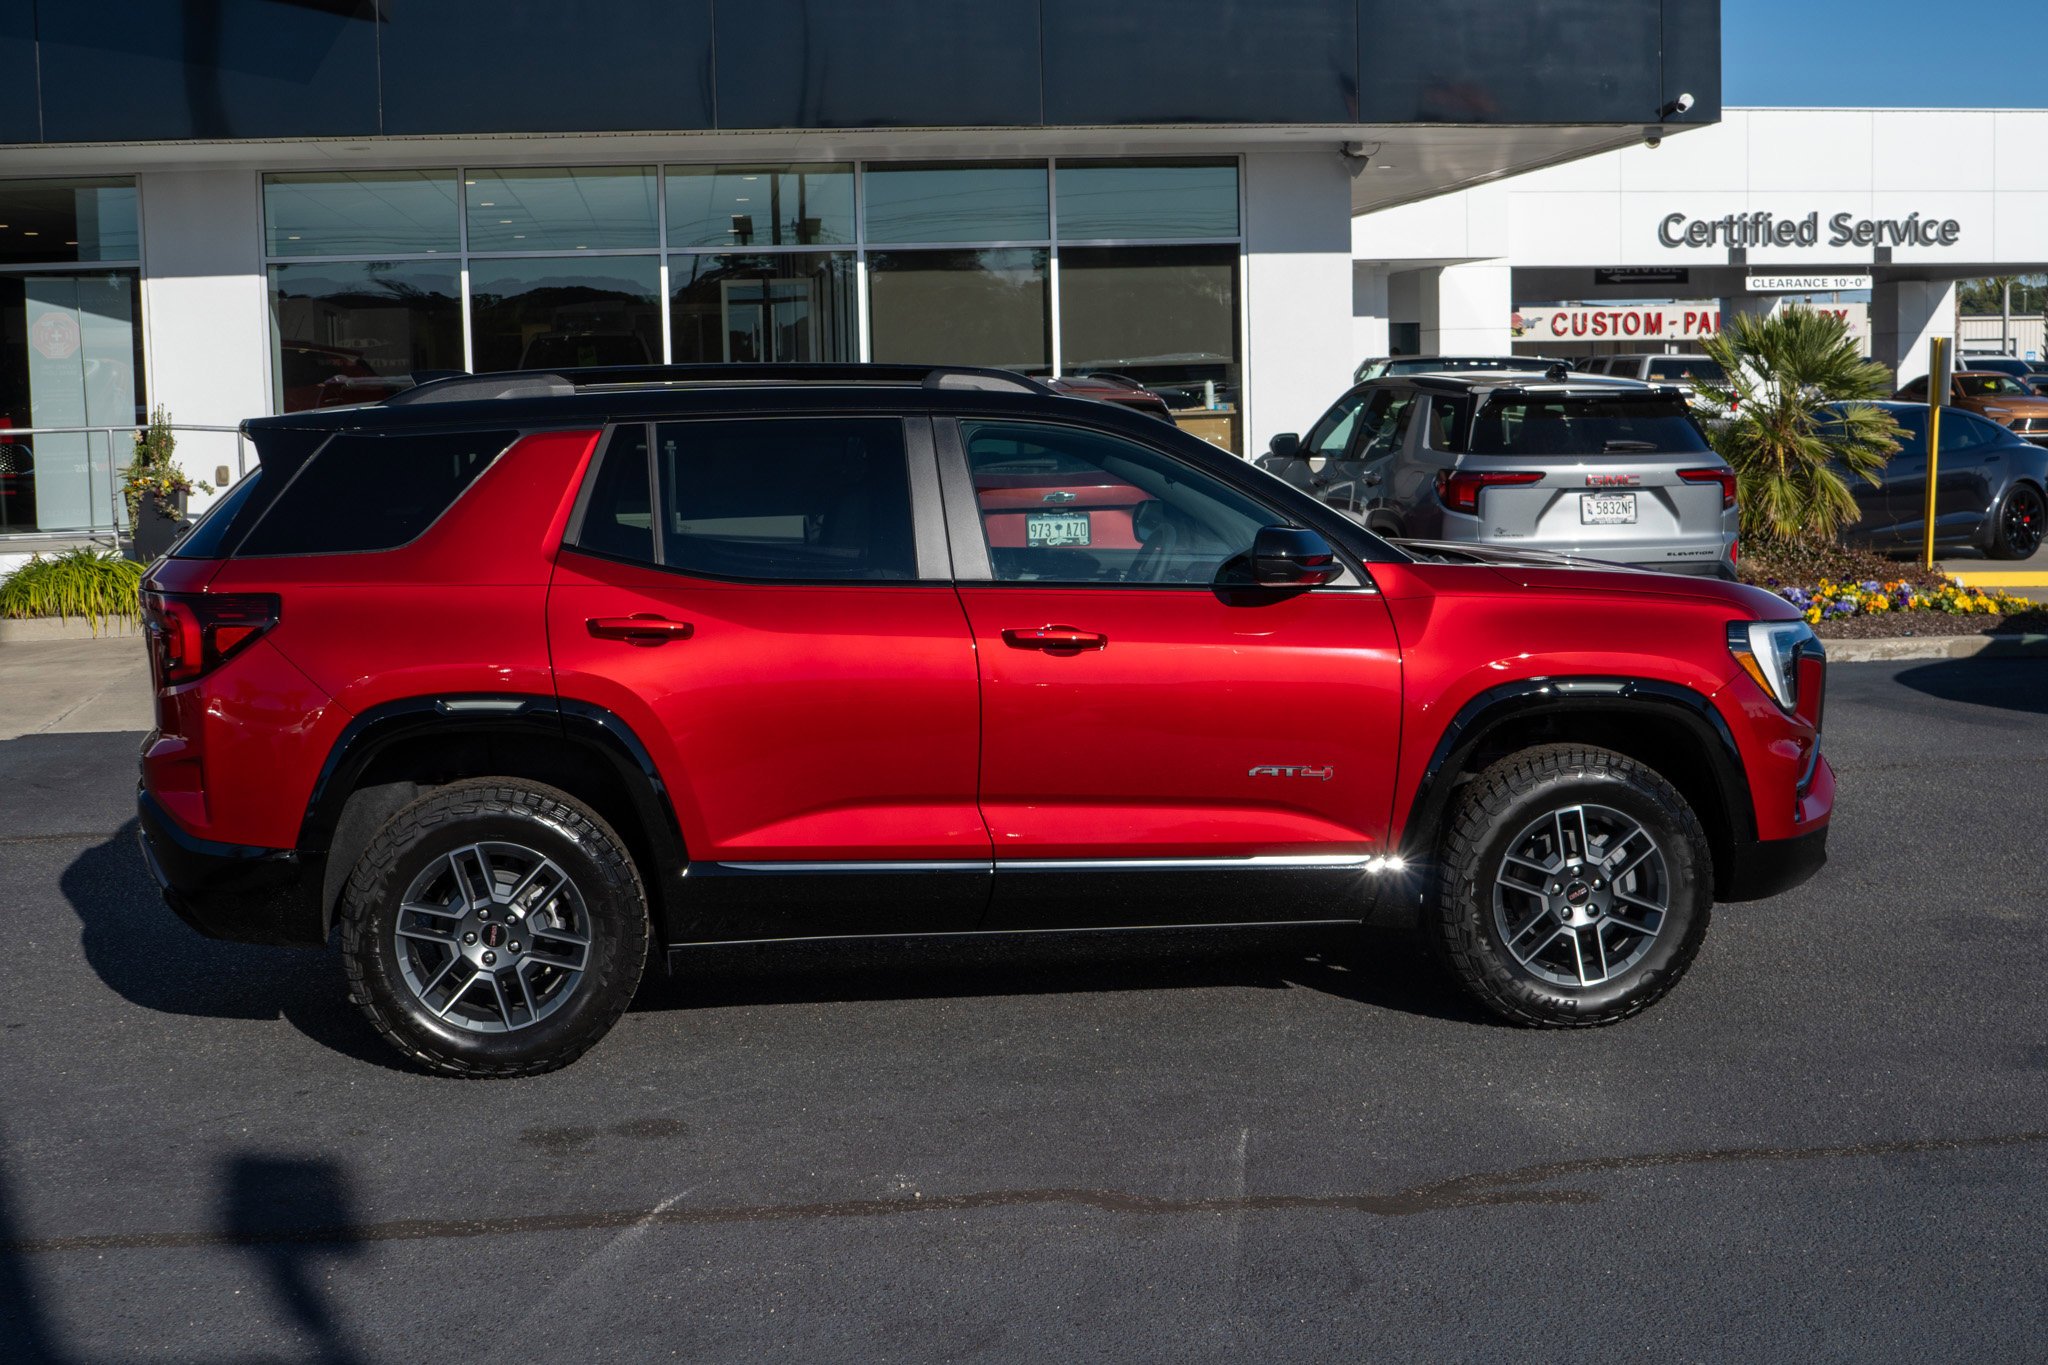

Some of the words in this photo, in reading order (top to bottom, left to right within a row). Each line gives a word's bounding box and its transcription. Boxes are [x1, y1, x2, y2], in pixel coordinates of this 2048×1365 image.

[1657, 211, 1819, 249] Certified
[1828, 211, 1961, 248] Service
[1752, 278, 1829, 288] CLEARANCE
[1585, 474, 1640, 487] GMC
[1596, 501, 1634, 515] 5832NF
[1030, 523, 1051, 538] 973
[1248, 765, 1334, 781] AT4
